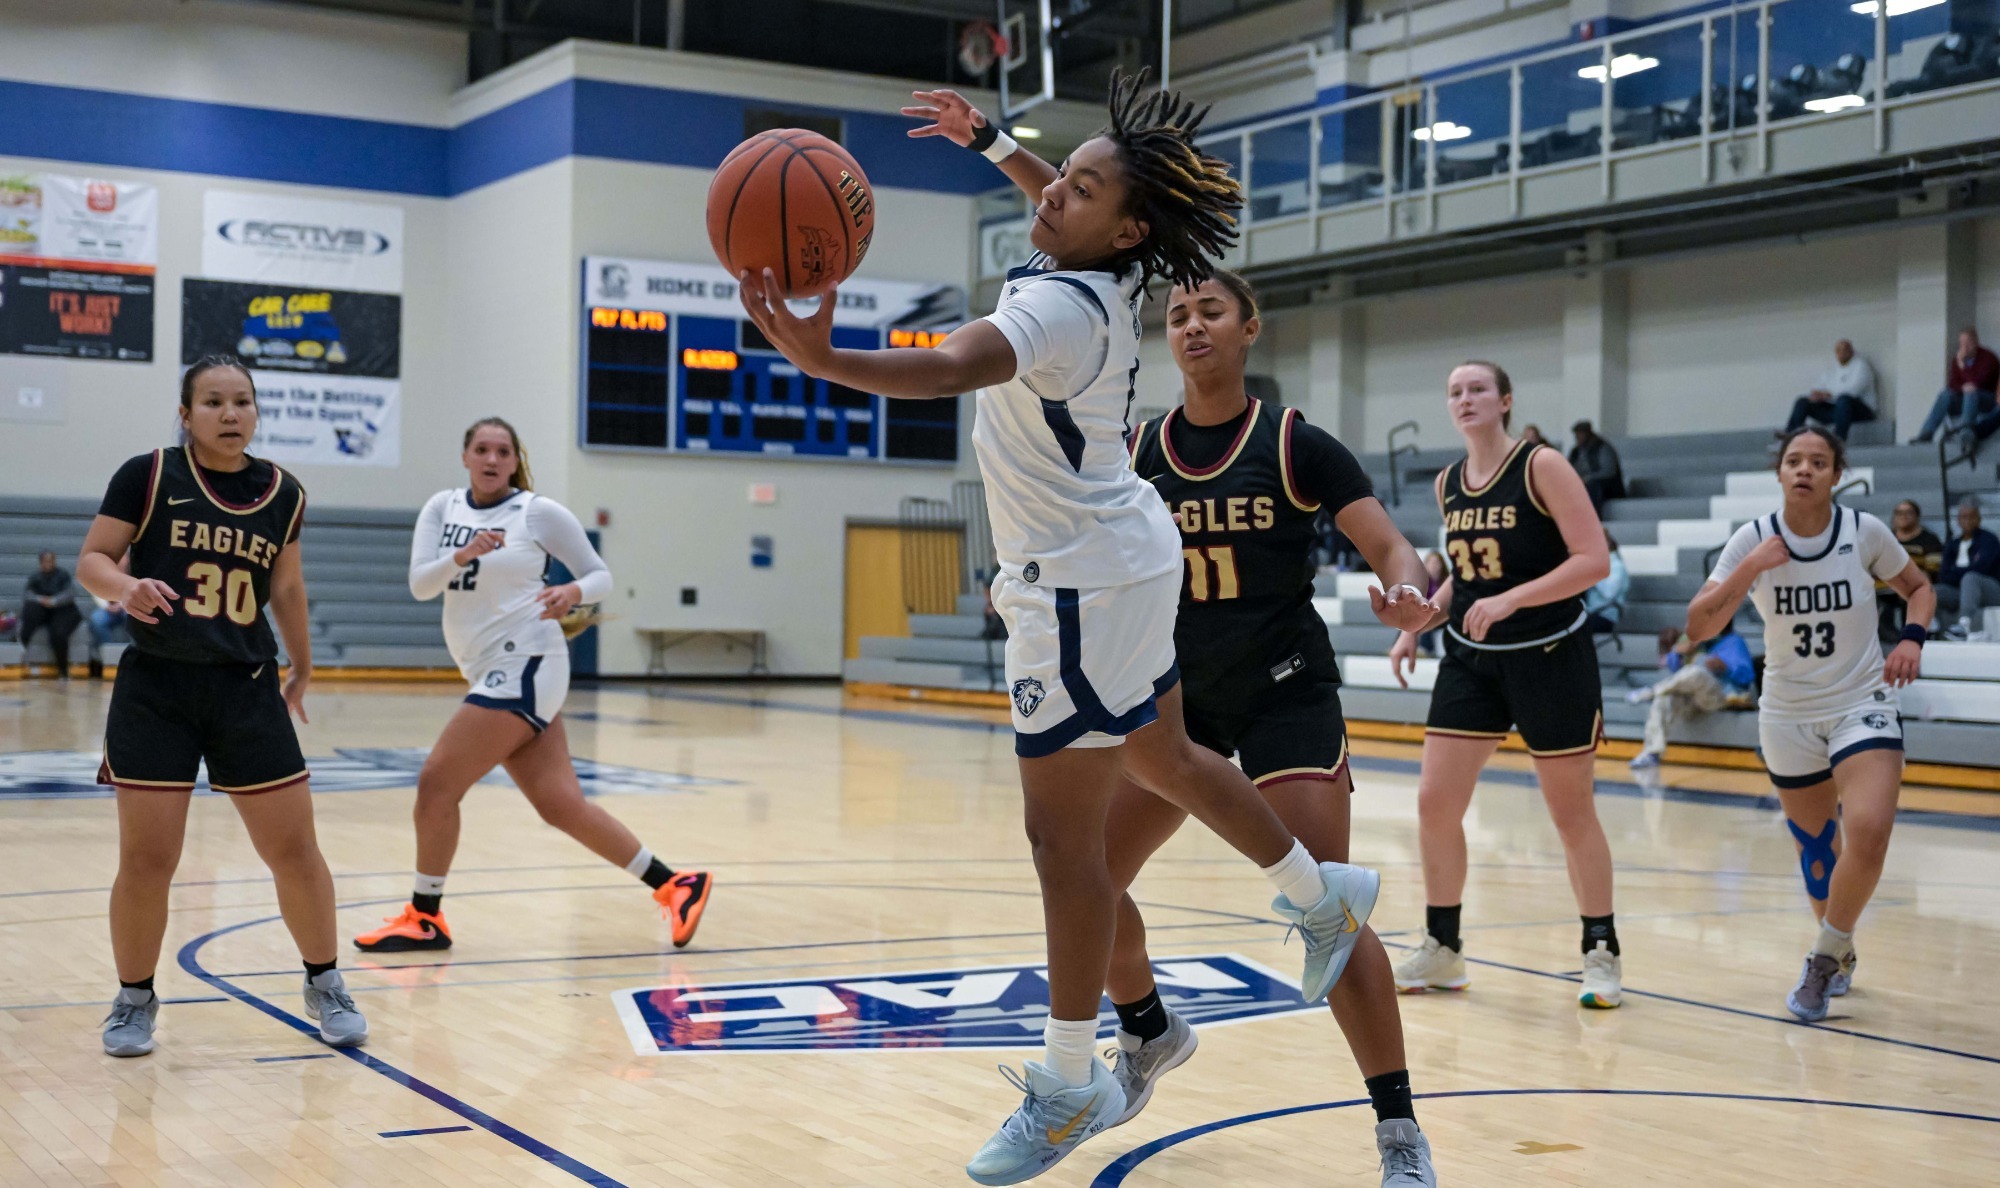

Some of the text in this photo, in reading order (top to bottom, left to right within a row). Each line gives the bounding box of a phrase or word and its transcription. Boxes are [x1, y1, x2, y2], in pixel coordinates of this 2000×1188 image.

[837, 170, 872, 229] THE
[646, 277, 736, 300] HOME OF
[170, 519, 278, 570] EAGLES
[1447, 537, 1503, 582] 33
[184, 561, 258, 626] 30
[1774, 579, 1853, 615] HOOD
[1792, 621, 1836, 658] 33
